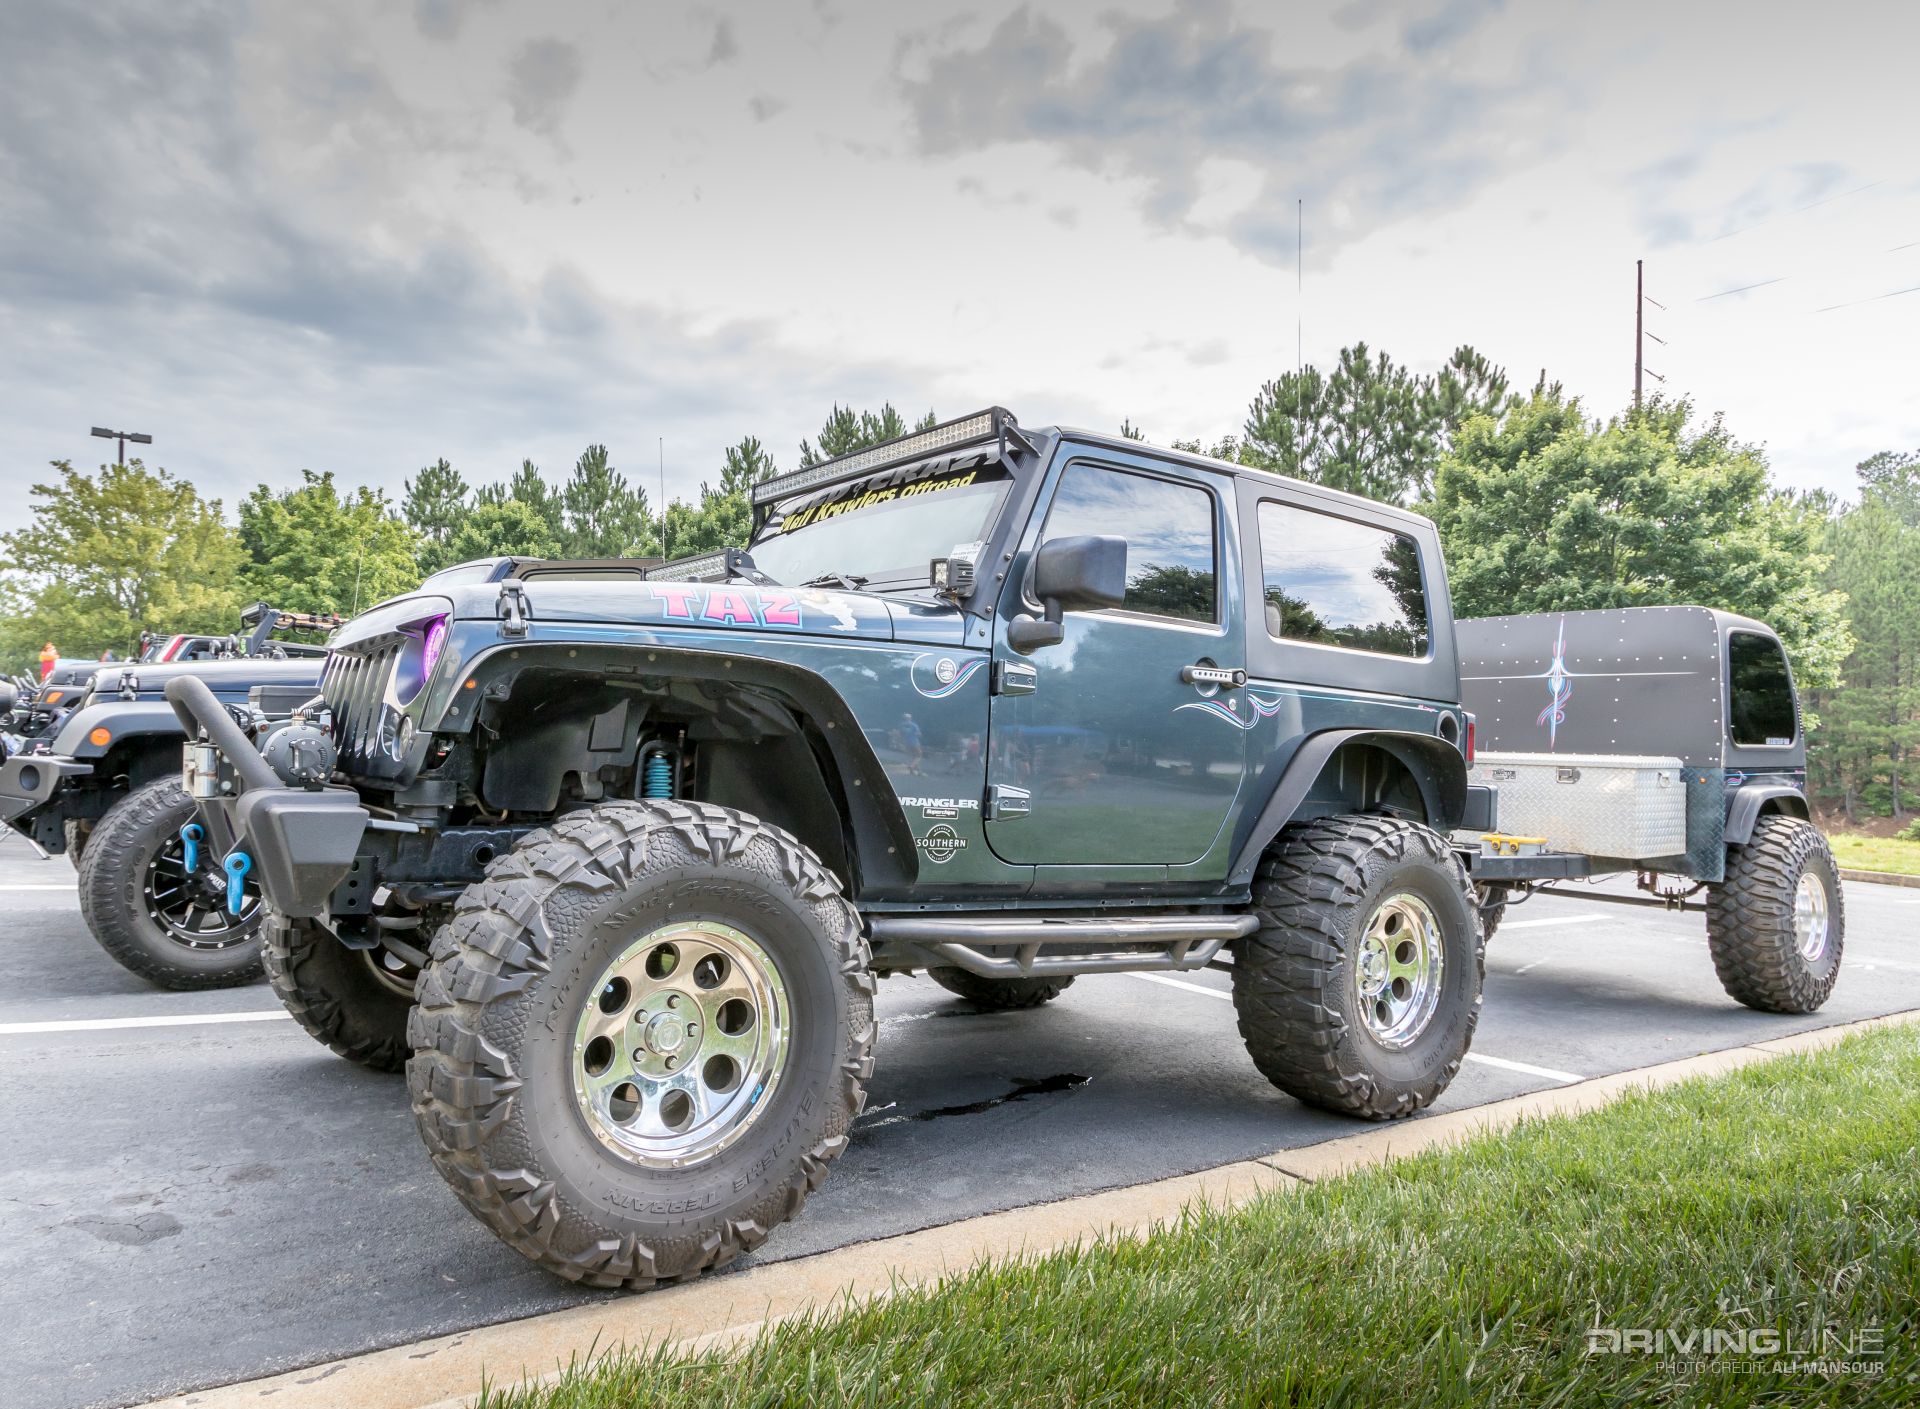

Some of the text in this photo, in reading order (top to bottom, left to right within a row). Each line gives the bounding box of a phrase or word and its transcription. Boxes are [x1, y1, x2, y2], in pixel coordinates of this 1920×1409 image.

[812, 488, 898, 523] Krawlers
[901, 471, 977, 499] Offroad
[648, 586, 803, 629] TAZ
[916, 838, 966, 847] SOUTHERN
[602, 1188, 721, 1214] TERRAIN
